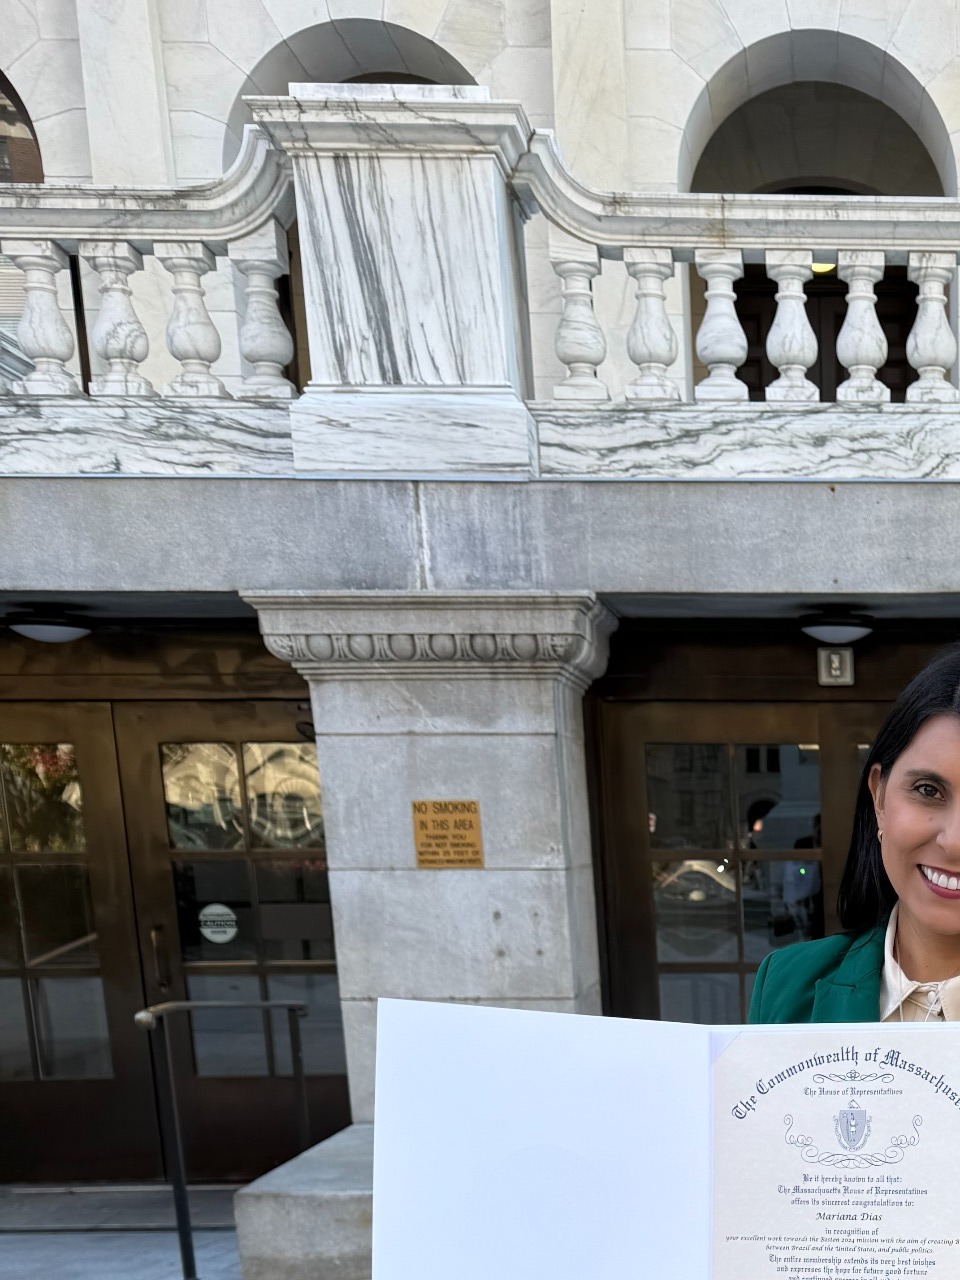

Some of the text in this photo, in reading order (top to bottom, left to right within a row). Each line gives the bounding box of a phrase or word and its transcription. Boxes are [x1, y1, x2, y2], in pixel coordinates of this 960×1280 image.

[413, 801, 478, 814] NO SMOKING
[420, 819, 474, 831] IN THIS AREA
[731, 1095, 757, 1120] The
[756, 1045, 859, 1096] Commonwealth
[865, 1047, 881, 1062] of
[804, 1087, 902, 1096] The House of Representatives
[803, 1174, 812, 1184] Be
[821, 1174, 842, 1184] hereby
[844, 1174, 865, 1183] known
[868, 1175, 873, 1183] to
[876, 1175, 884, 1183] all
[886, 1175, 902, 1185] that:
[778, 1185, 928, 1196] The Massachusetts House of Representatives
[852, 1199, 903, 1207] congratulations
[816, 1212, 882, 1221] Mariana Dias
[834, 1228, 869, 1237] recognition
[769, 1254, 781, 1263] The
[784, 1255, 801, 1263] entire
[804, 1256, 841, 1265] membership
[844, 1257, 868, 1265] extends
[880, 1258, 895, 1266] very
[913, 1258, 936, 1267] wishes
[823, 1266, 833, 1274] the
[835, 1266, 850, 1274] hope
[885, 1267, 901, 1276] good
[904, 1267, 928, 1275] fortune
